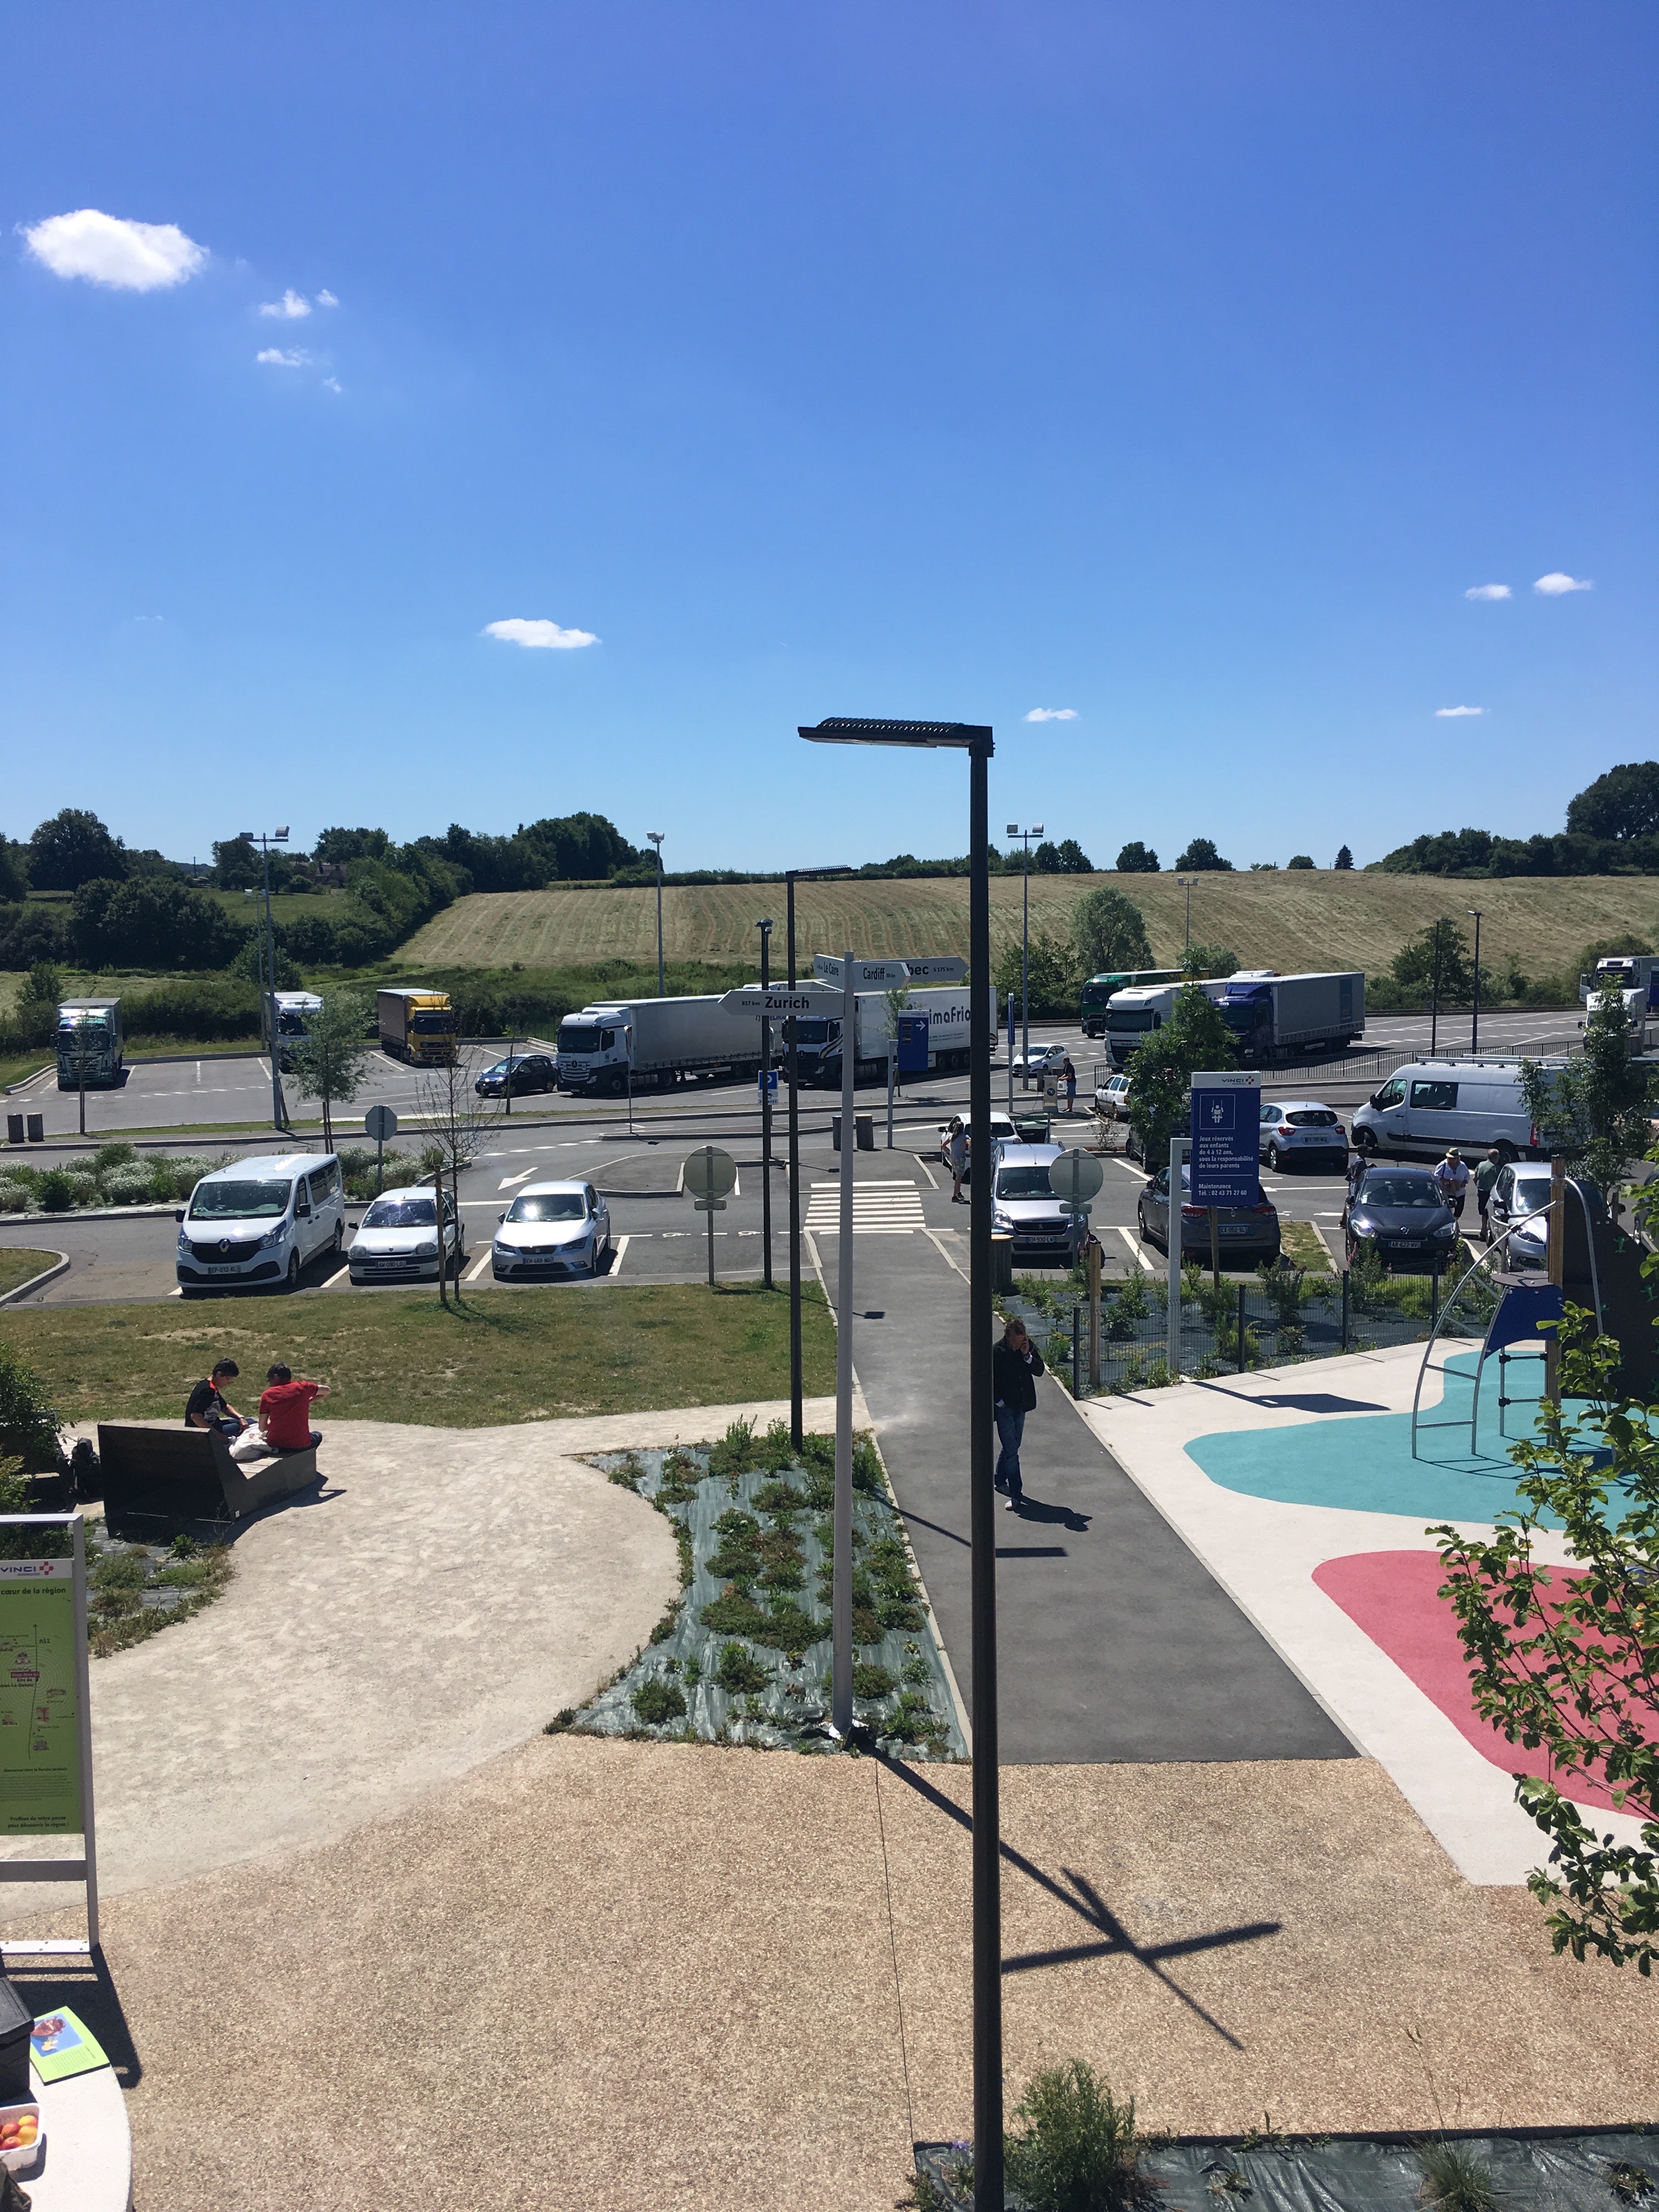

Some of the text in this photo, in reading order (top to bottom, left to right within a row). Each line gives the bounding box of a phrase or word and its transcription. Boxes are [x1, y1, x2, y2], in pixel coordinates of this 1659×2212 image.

[824, 962, 828, 973] Le
[829, 963, 839, 976] Caire
[863, 967, 885, 980] Cardiff
[907, 964, 929, 975] bec
[765, 996, 809, 1008] Zurich
[42, 1587, 66, 1595] région
